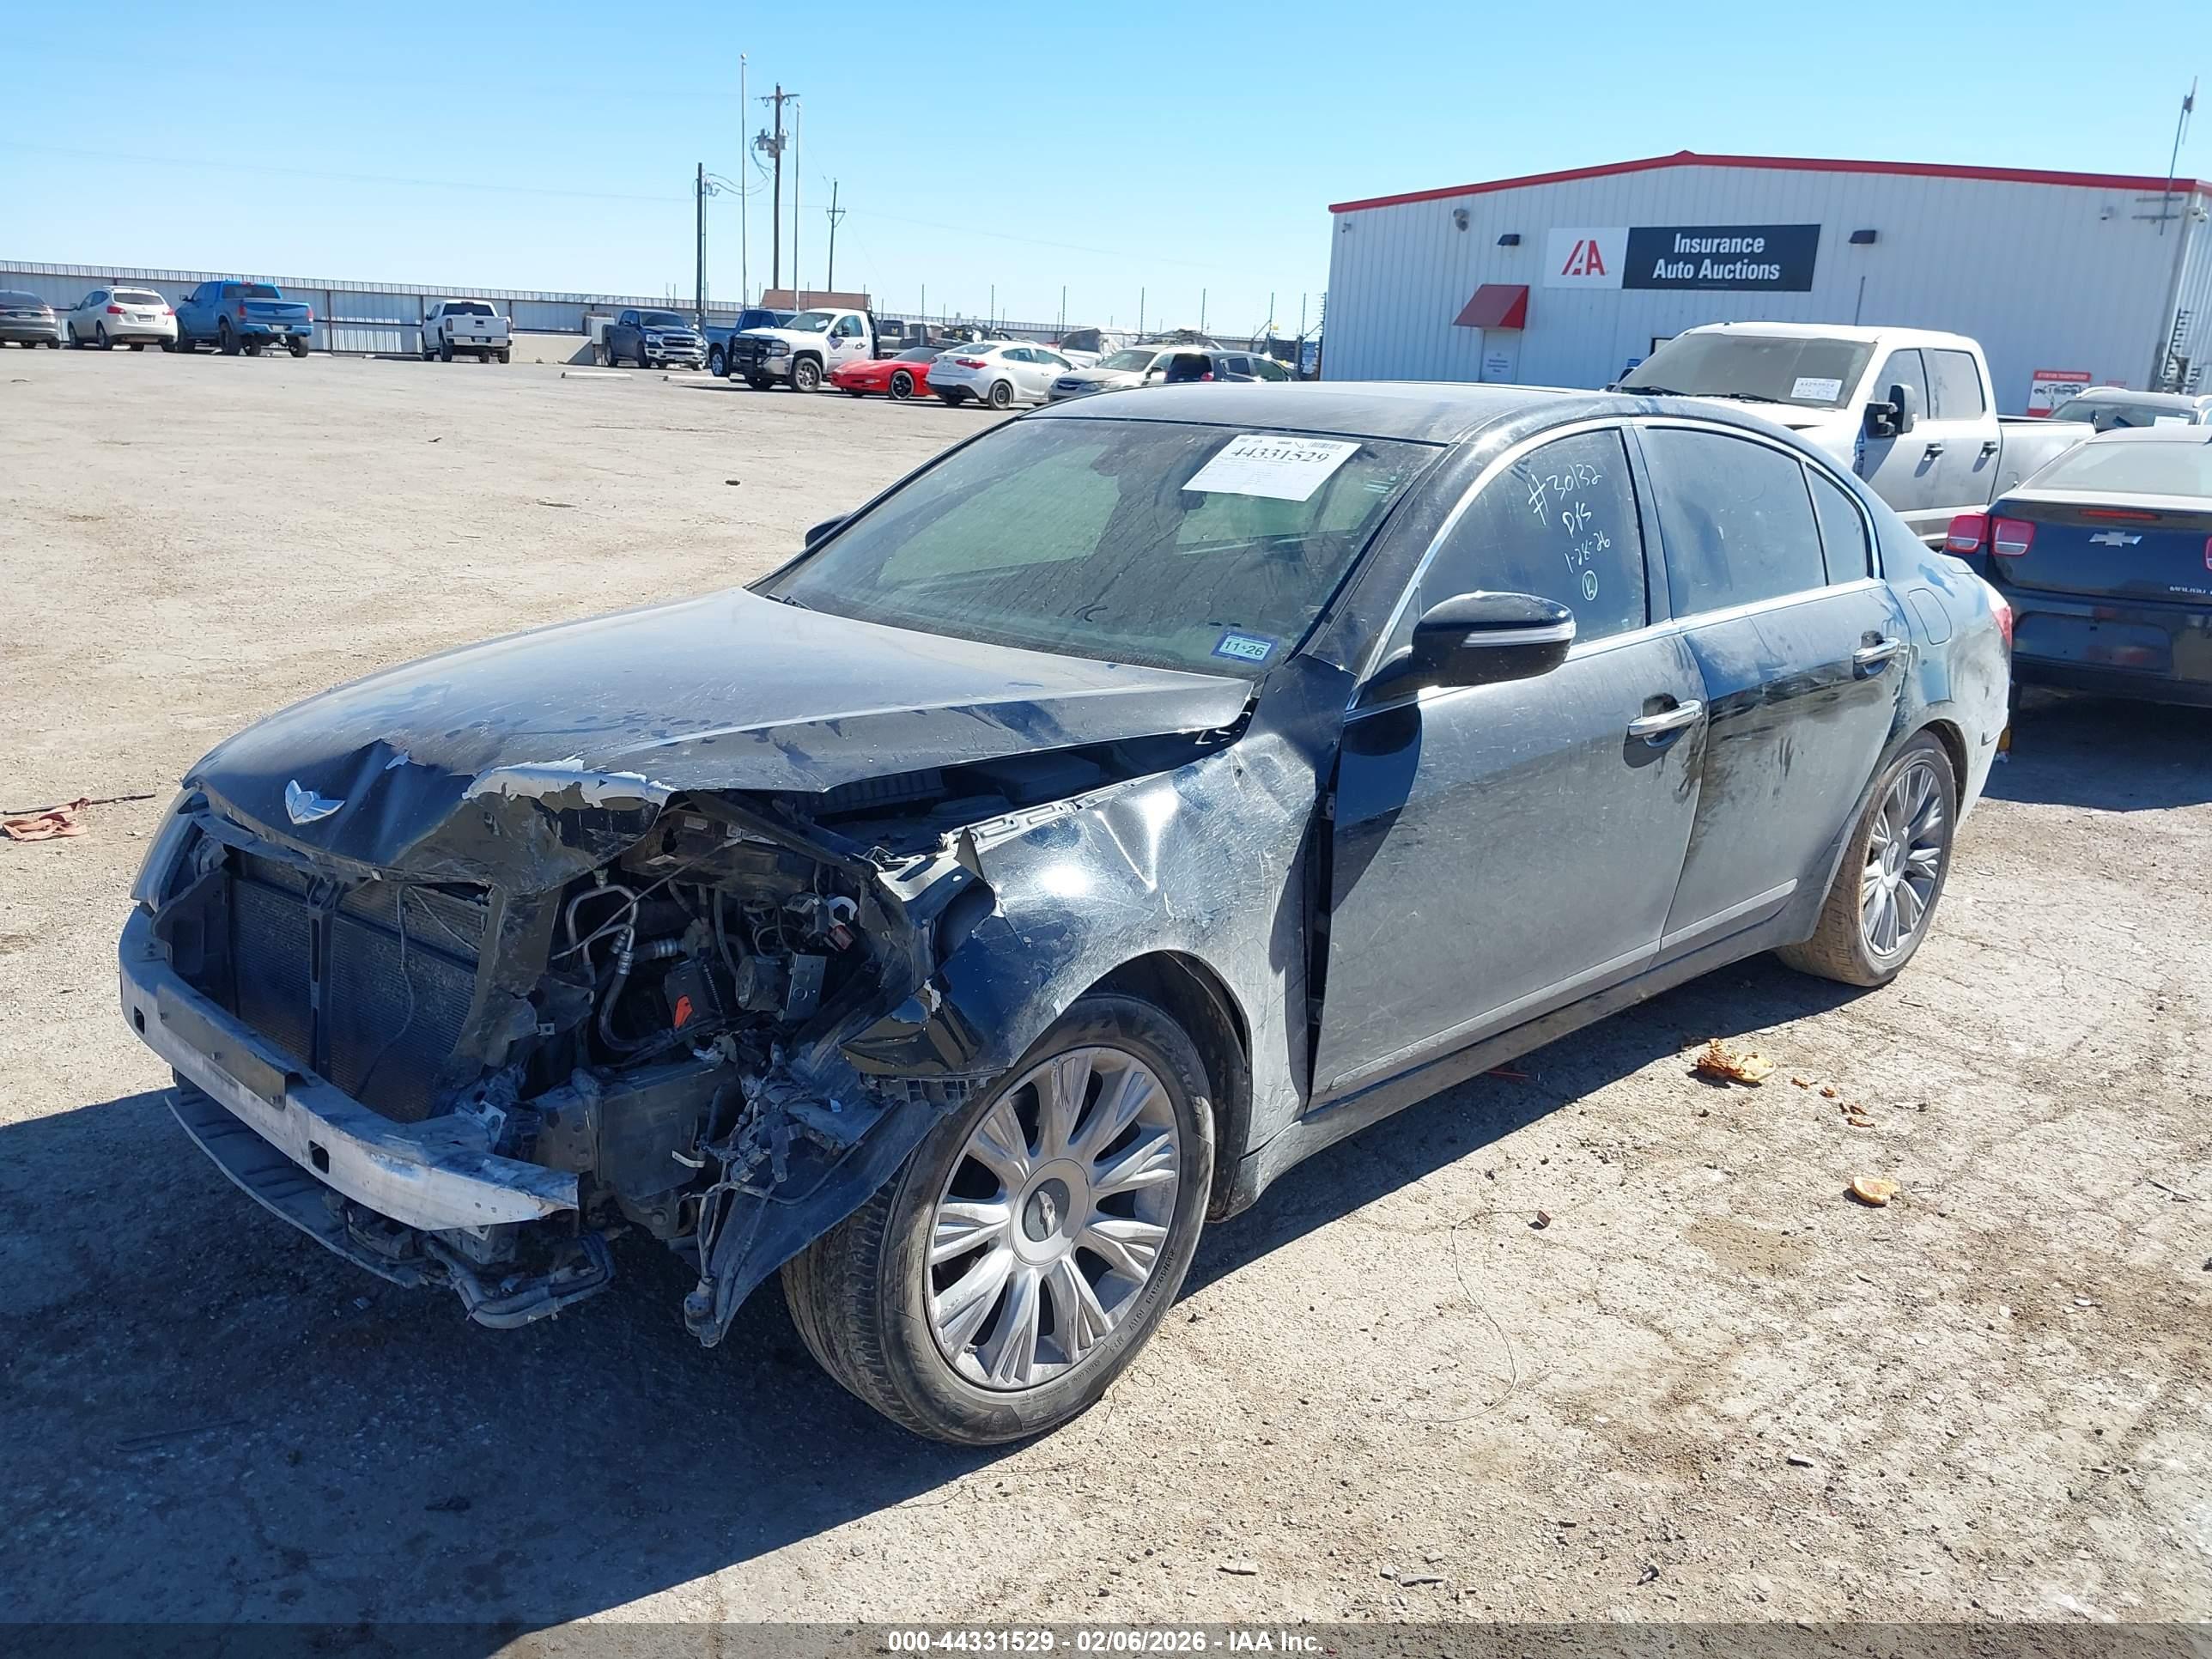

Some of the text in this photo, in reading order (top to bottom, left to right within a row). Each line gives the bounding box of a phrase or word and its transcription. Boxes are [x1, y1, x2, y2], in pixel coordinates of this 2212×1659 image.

[1674, 234, 1764, 253] Insurance
[1652, 259, 1780, 280] Auto Auctions
[1231, 447, 1329, 463] 44331529
